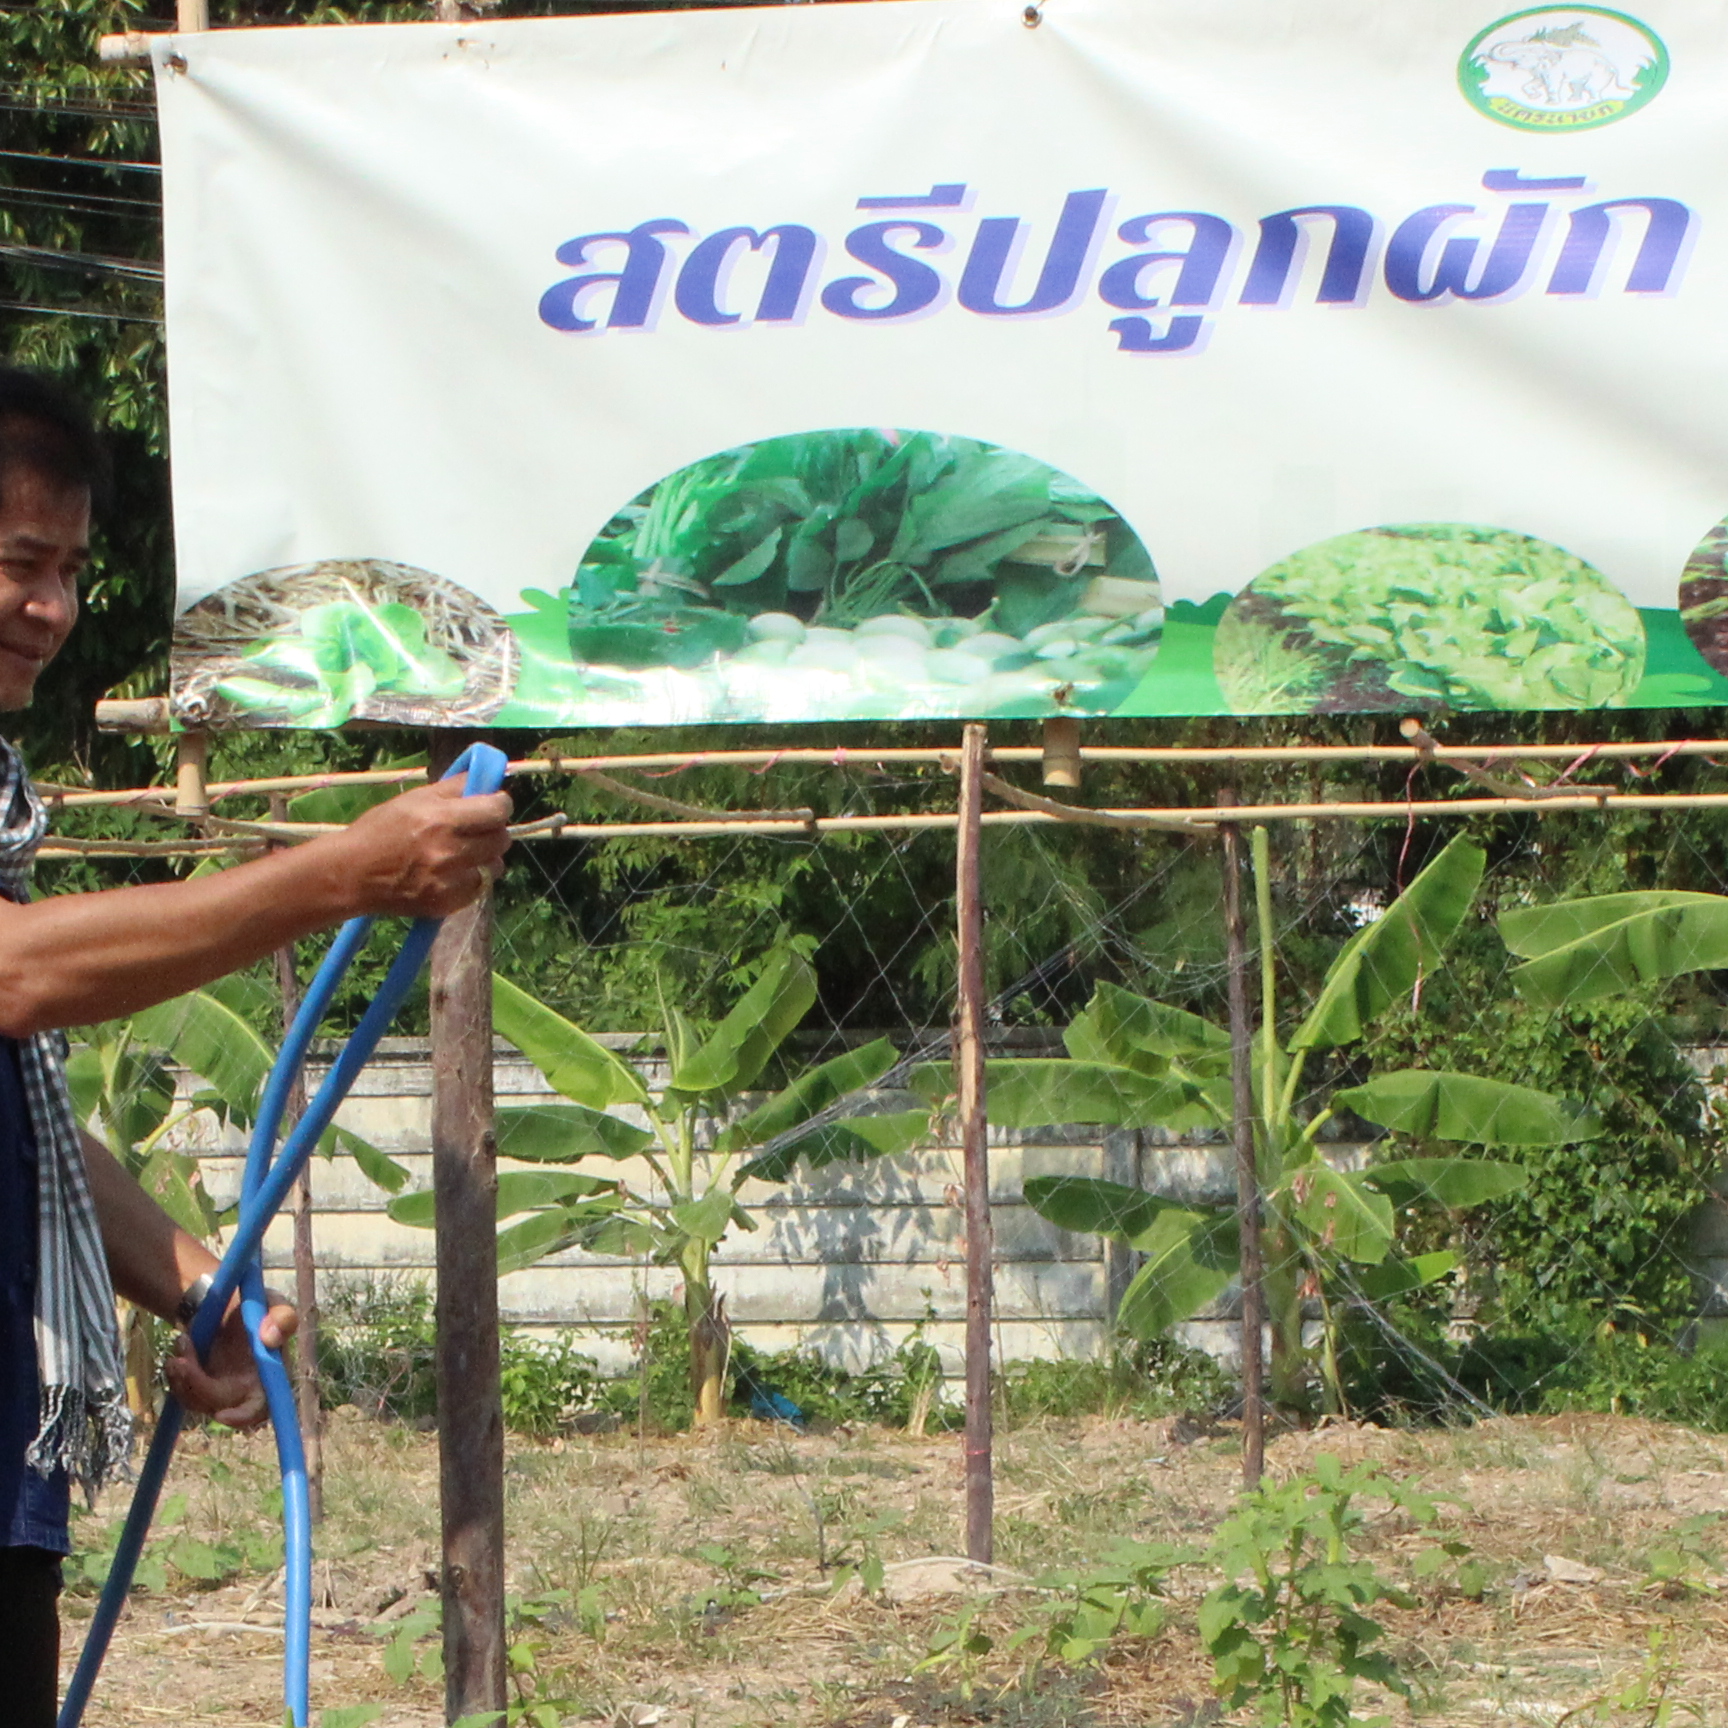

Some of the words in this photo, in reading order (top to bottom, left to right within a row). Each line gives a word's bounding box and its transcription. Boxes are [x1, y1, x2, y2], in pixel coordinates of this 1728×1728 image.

[538, 167, 1700, 356] สตรีปลูกผัก
